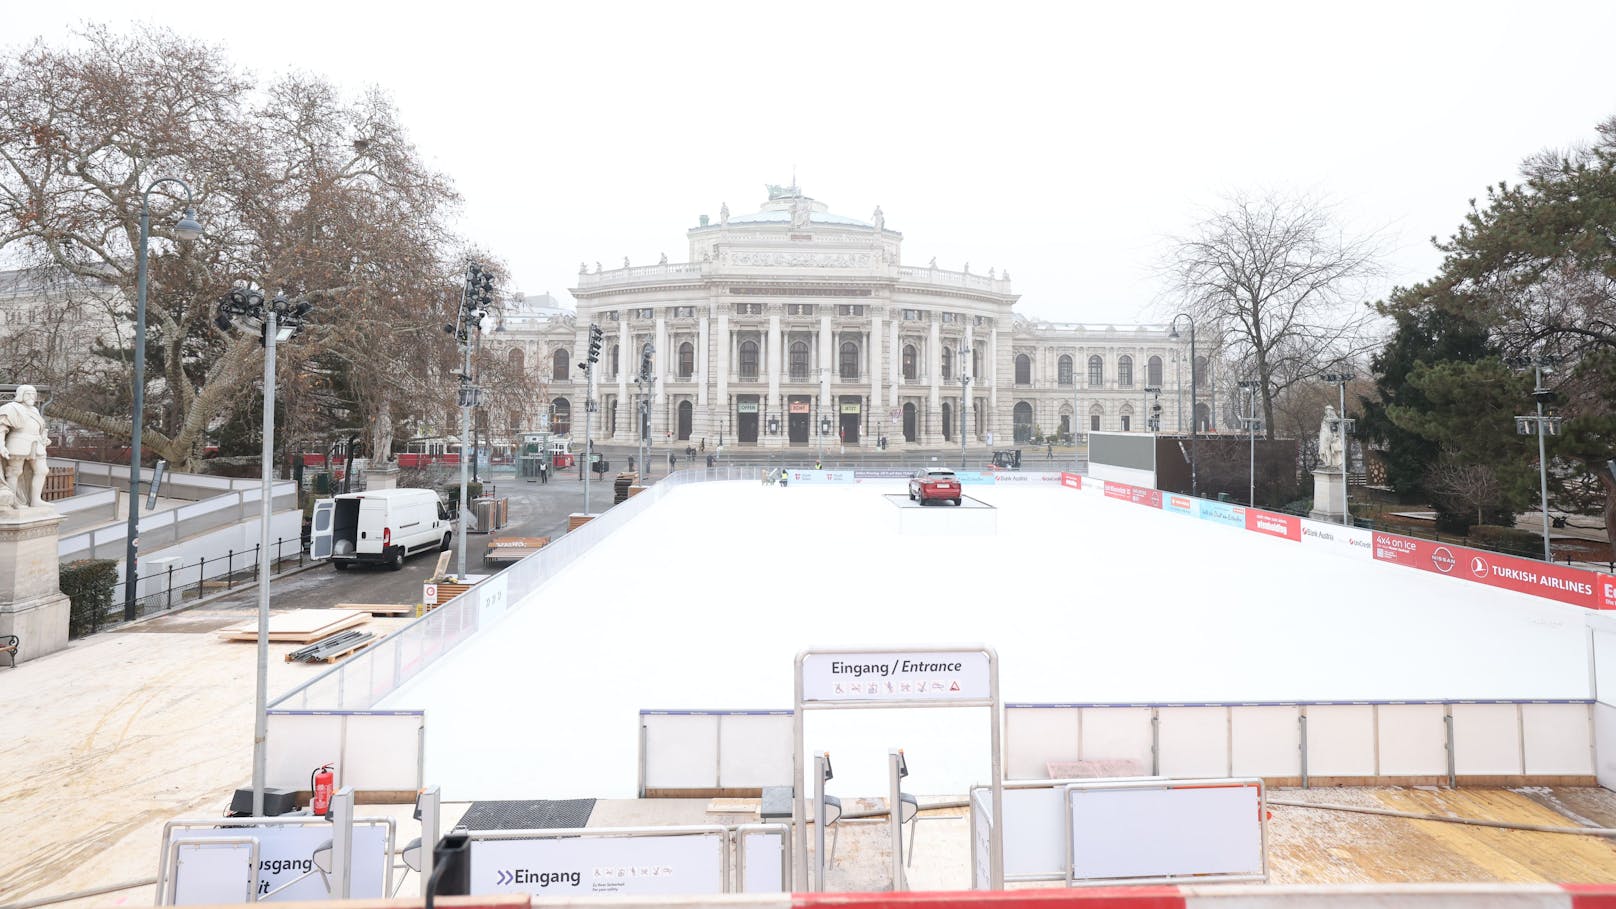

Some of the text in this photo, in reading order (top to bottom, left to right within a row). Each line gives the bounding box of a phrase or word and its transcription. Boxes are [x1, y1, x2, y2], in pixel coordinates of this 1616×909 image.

[1307, 529, 1318, 537] Bank
[1319, 530, 1334, 541] Austria
[1377, 536, 1391, 545] 4x4
[1392, 540, 1403, 548] on
[1432, 555, 1456, 564] NISSAN
[1492, 565, 1593, 595] TURKISH AIRLINES
[832, 661, 889, 677] Eingang
[901, 660, 962, 673] Entrance
[259, 859, 312, 874] sgang
[515, 869, 581, 887] Eingang
